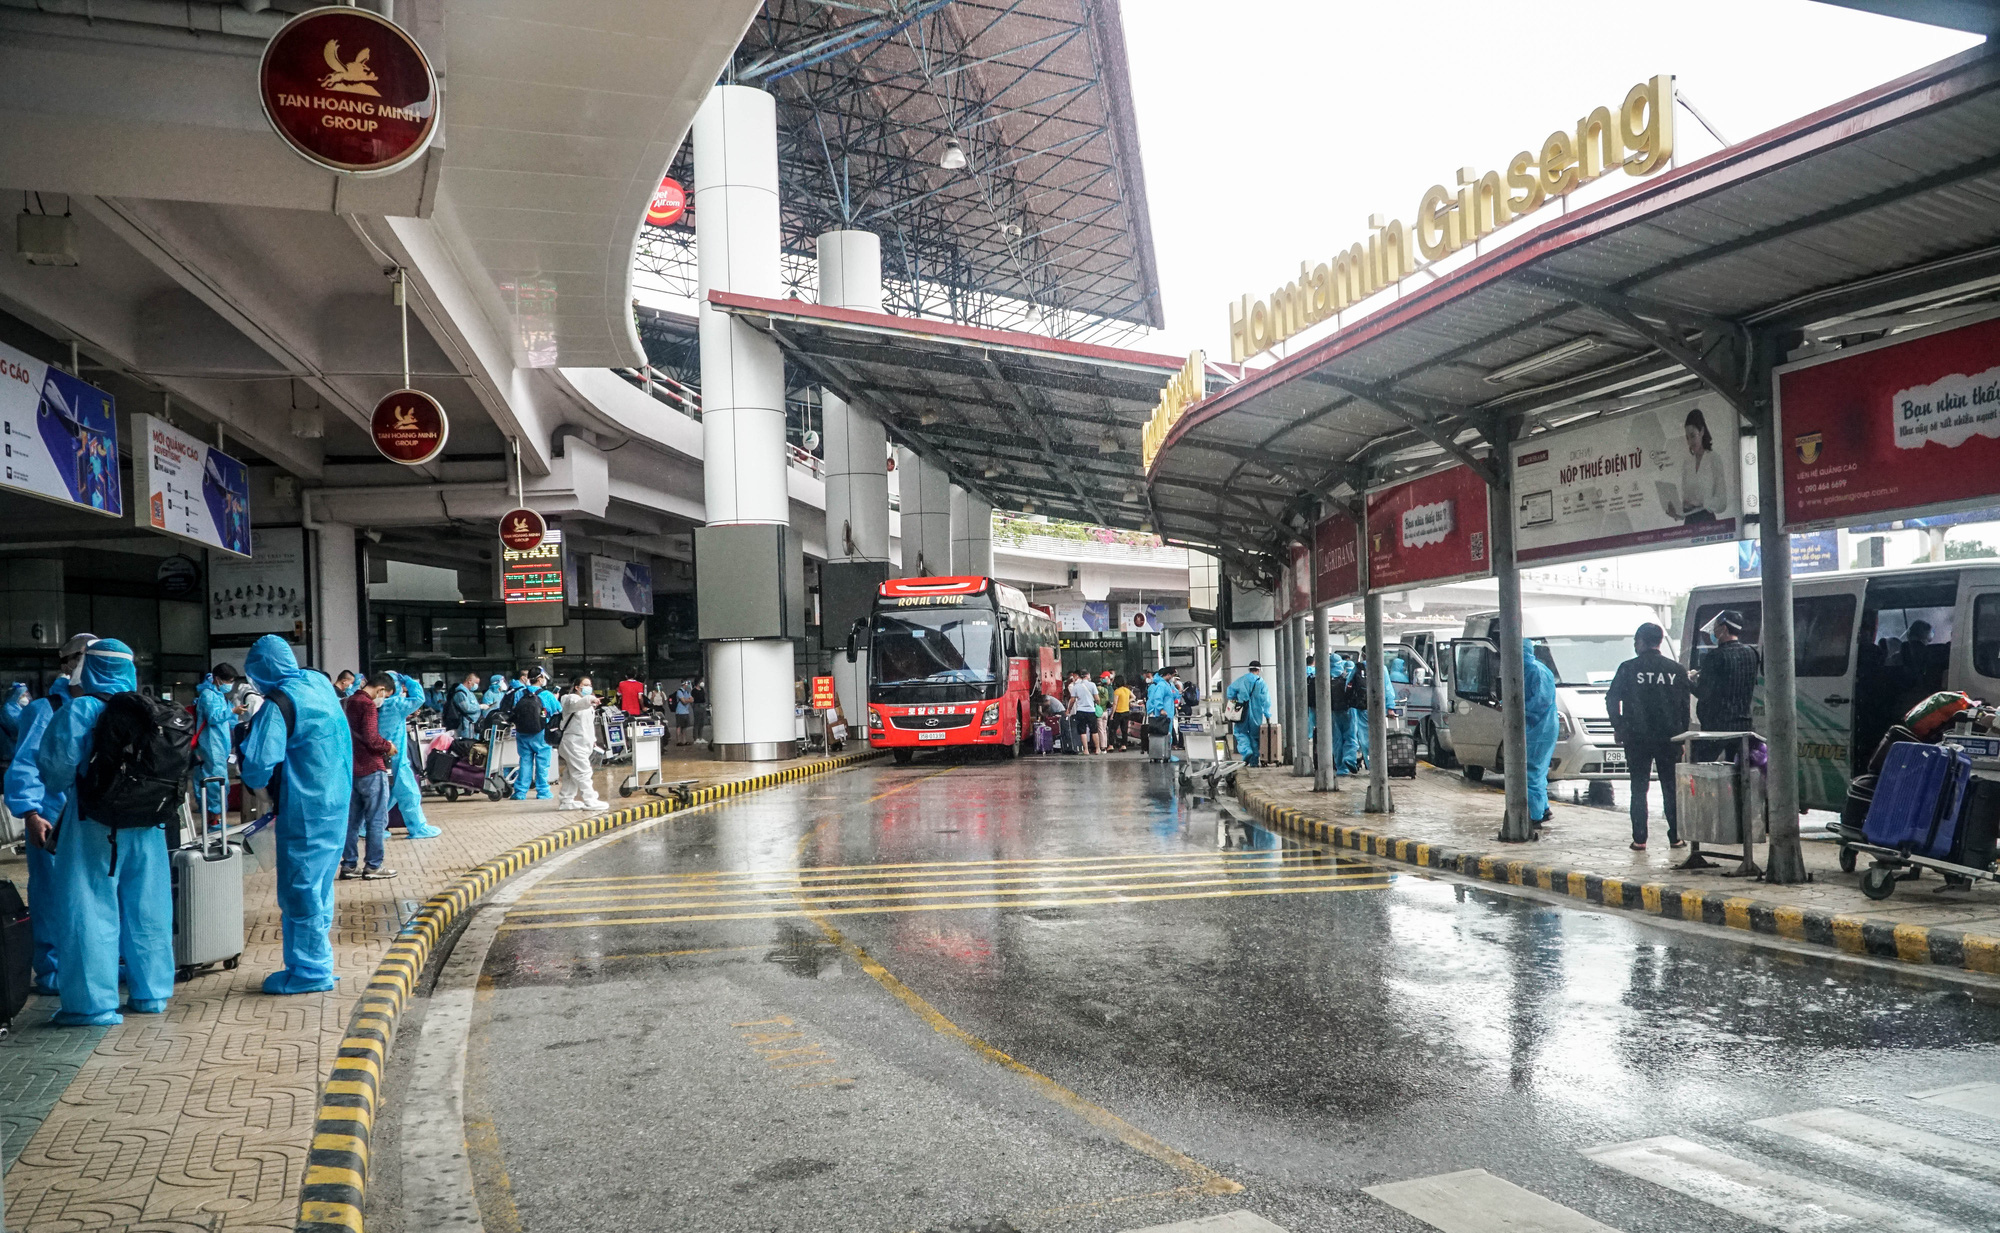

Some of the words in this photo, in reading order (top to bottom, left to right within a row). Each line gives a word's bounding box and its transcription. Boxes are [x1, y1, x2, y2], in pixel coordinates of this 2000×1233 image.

[278, 94, 310, 108] TAN
[314, 97, 374, 115] HOANG
[378, 105, 420, 123] MINH
[322, 115, 378, 132] GROUP
[1229, 212, 1414, 362] Homtamin
[1417, 74, 1673, 261] Ginseng
[9, 362, 30, 384] CÁO
[1901, 400, 1932, 422] Bạn
[1937, 392, 1968, 413] nhìn
[1560, 465, 1578, 487] NỘP
[1580, 456, 1603, 481] THUẾ
[1604, 458, 1627, 477] ĐIỆN
[1628, 447, 1643, 468] TỬ
[1805, 484, 1817, 493] 090
[1818, 482, 1830, 491] 464
[1831, 479, 1847, 489] 6699
[898, 597, 931, 607] ROYAL
[936, 595, 963, 604] TOUR
[31, 622, 43, 640] 6
[529, 643, 535, 653] 4
[1637, 672, 1676, 685] STAY
